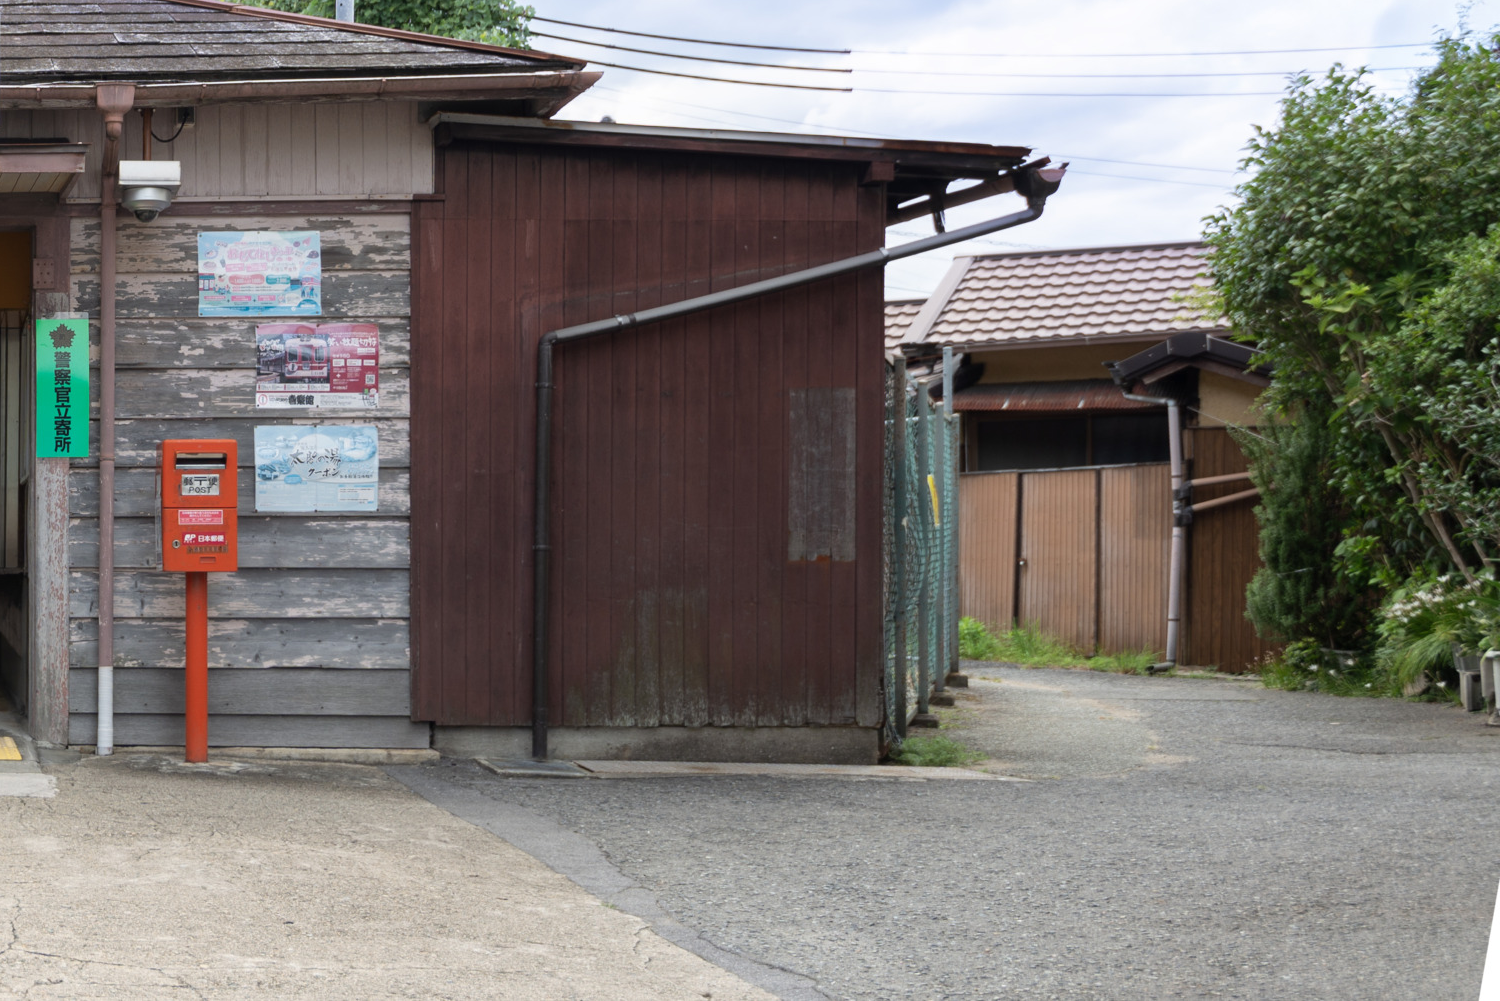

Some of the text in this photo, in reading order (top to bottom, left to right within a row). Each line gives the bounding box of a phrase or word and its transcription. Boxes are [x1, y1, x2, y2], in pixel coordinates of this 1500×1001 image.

[54, 351, 71, 453] 警察官立寄所
[308, 468, 340, 478] クーポン
